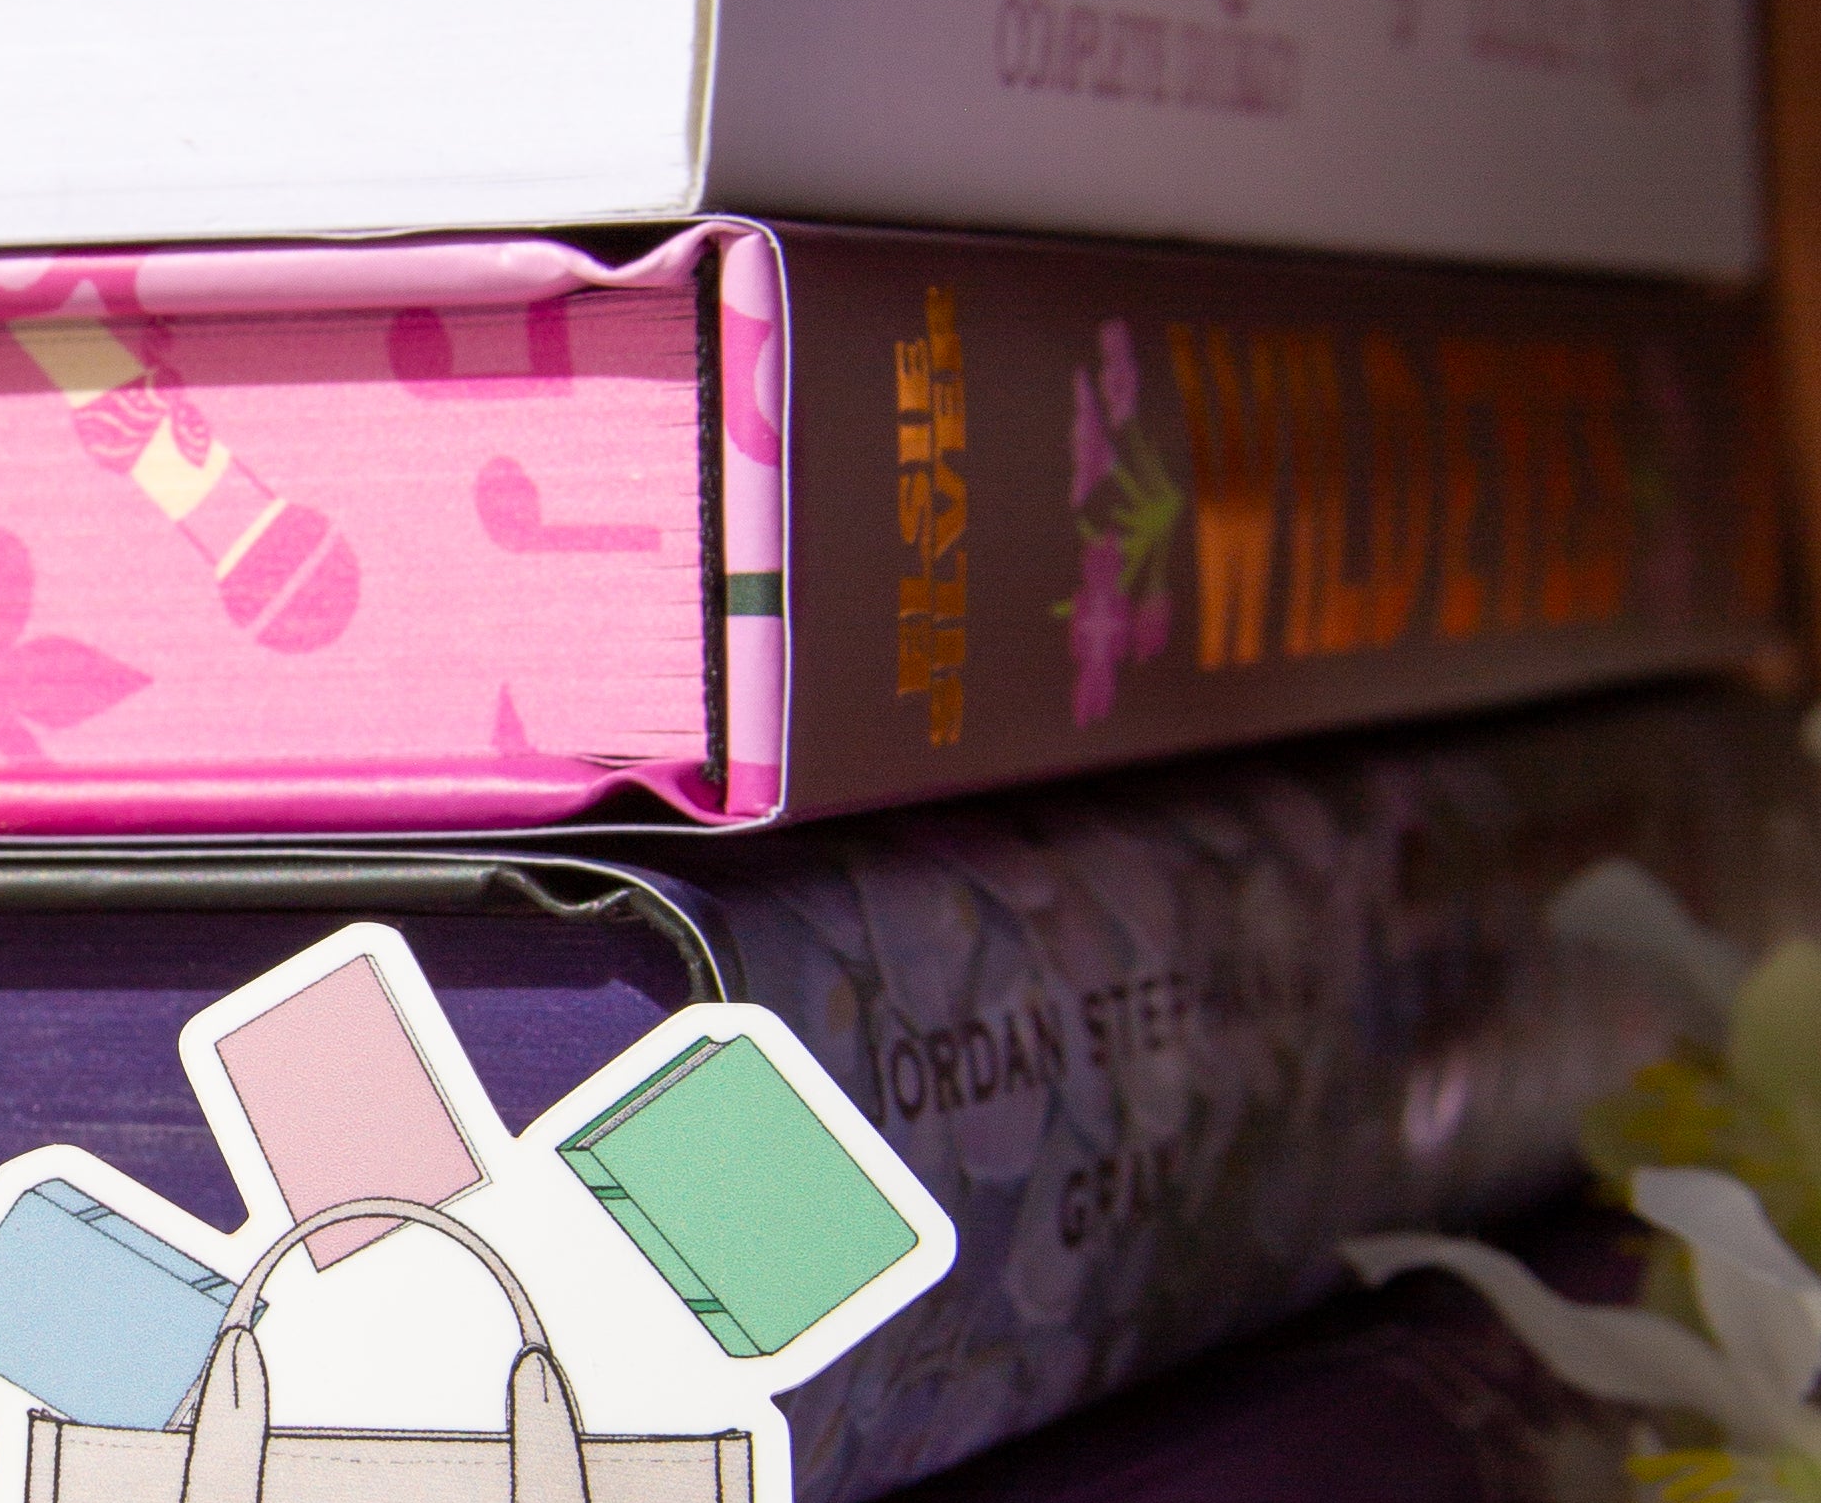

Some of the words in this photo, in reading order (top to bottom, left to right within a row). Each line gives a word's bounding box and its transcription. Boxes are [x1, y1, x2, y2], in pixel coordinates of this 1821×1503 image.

[895, 340, 931, 695] ELSIE
[927, 286, 967, 747] SILVER
[870, 1003, 1064, 1126] JORDAN
